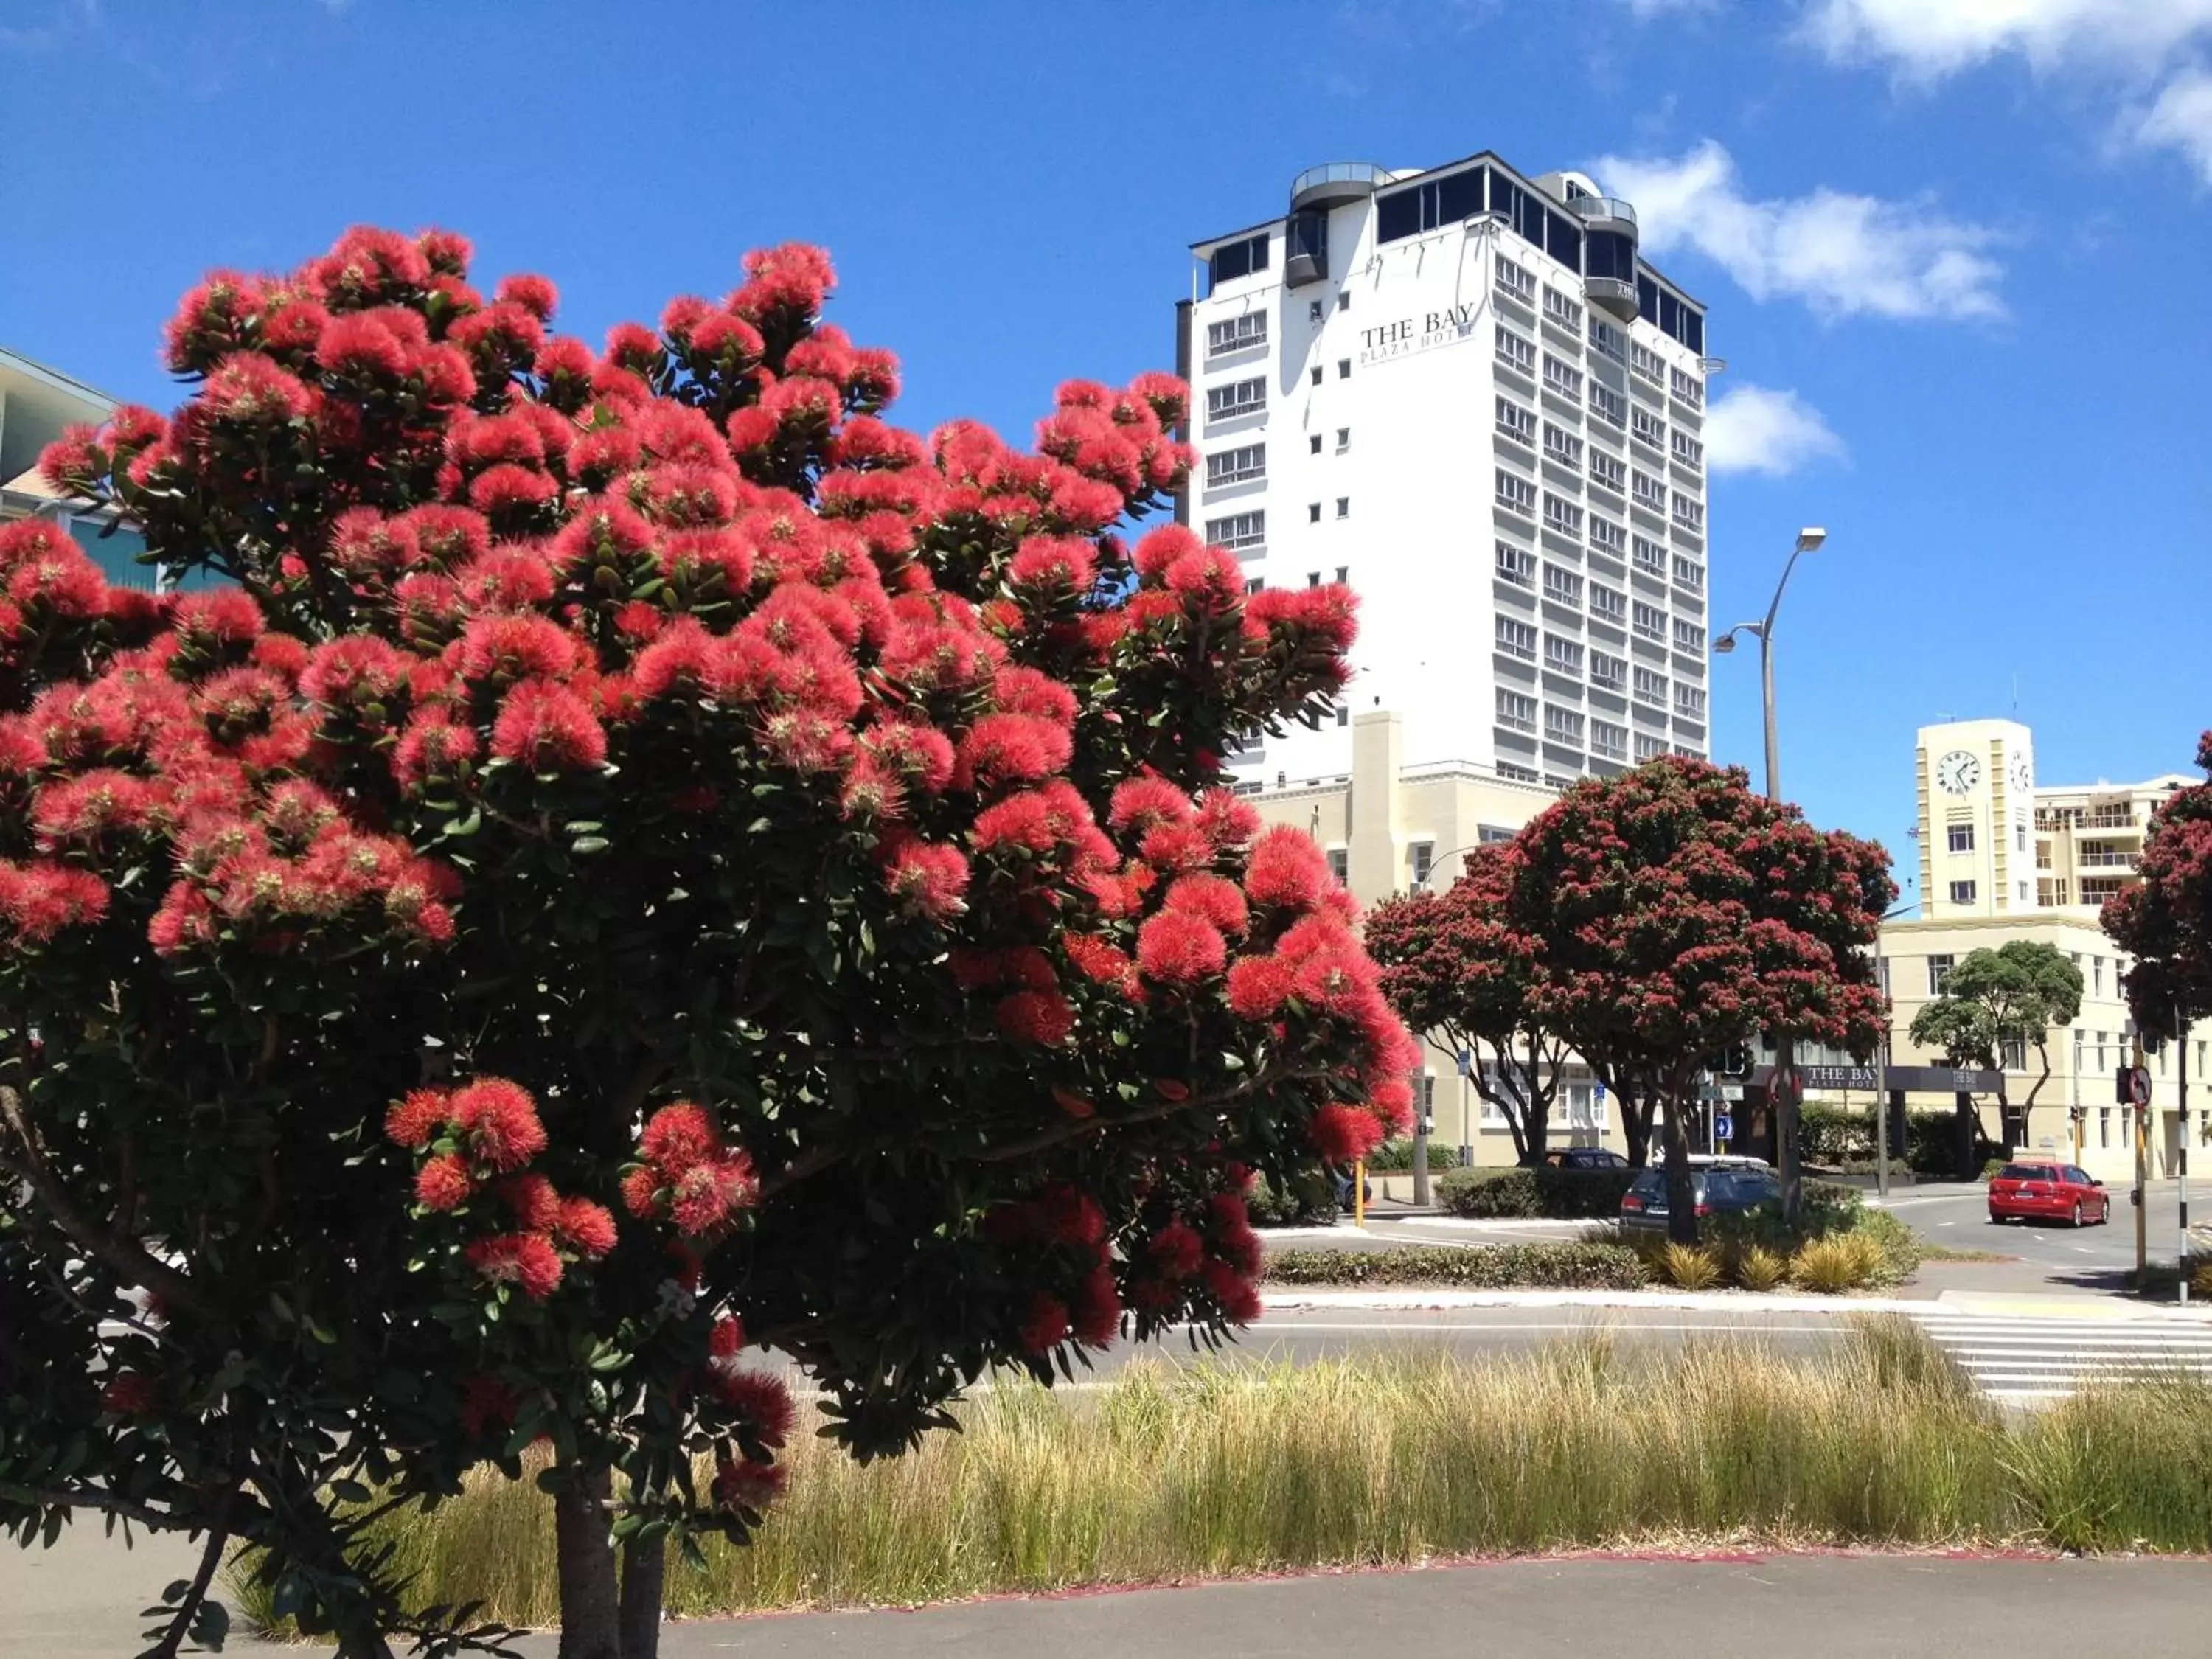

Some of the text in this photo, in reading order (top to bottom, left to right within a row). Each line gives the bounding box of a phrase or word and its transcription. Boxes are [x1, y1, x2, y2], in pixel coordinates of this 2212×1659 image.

[1361, 302, 1474, 348] THE BAY
[1360, 341, 1410, 364] PLAZA
[1808, 1067, 1845, 1080] THE
[1848, 1080, 1878, 1088] HOTE
